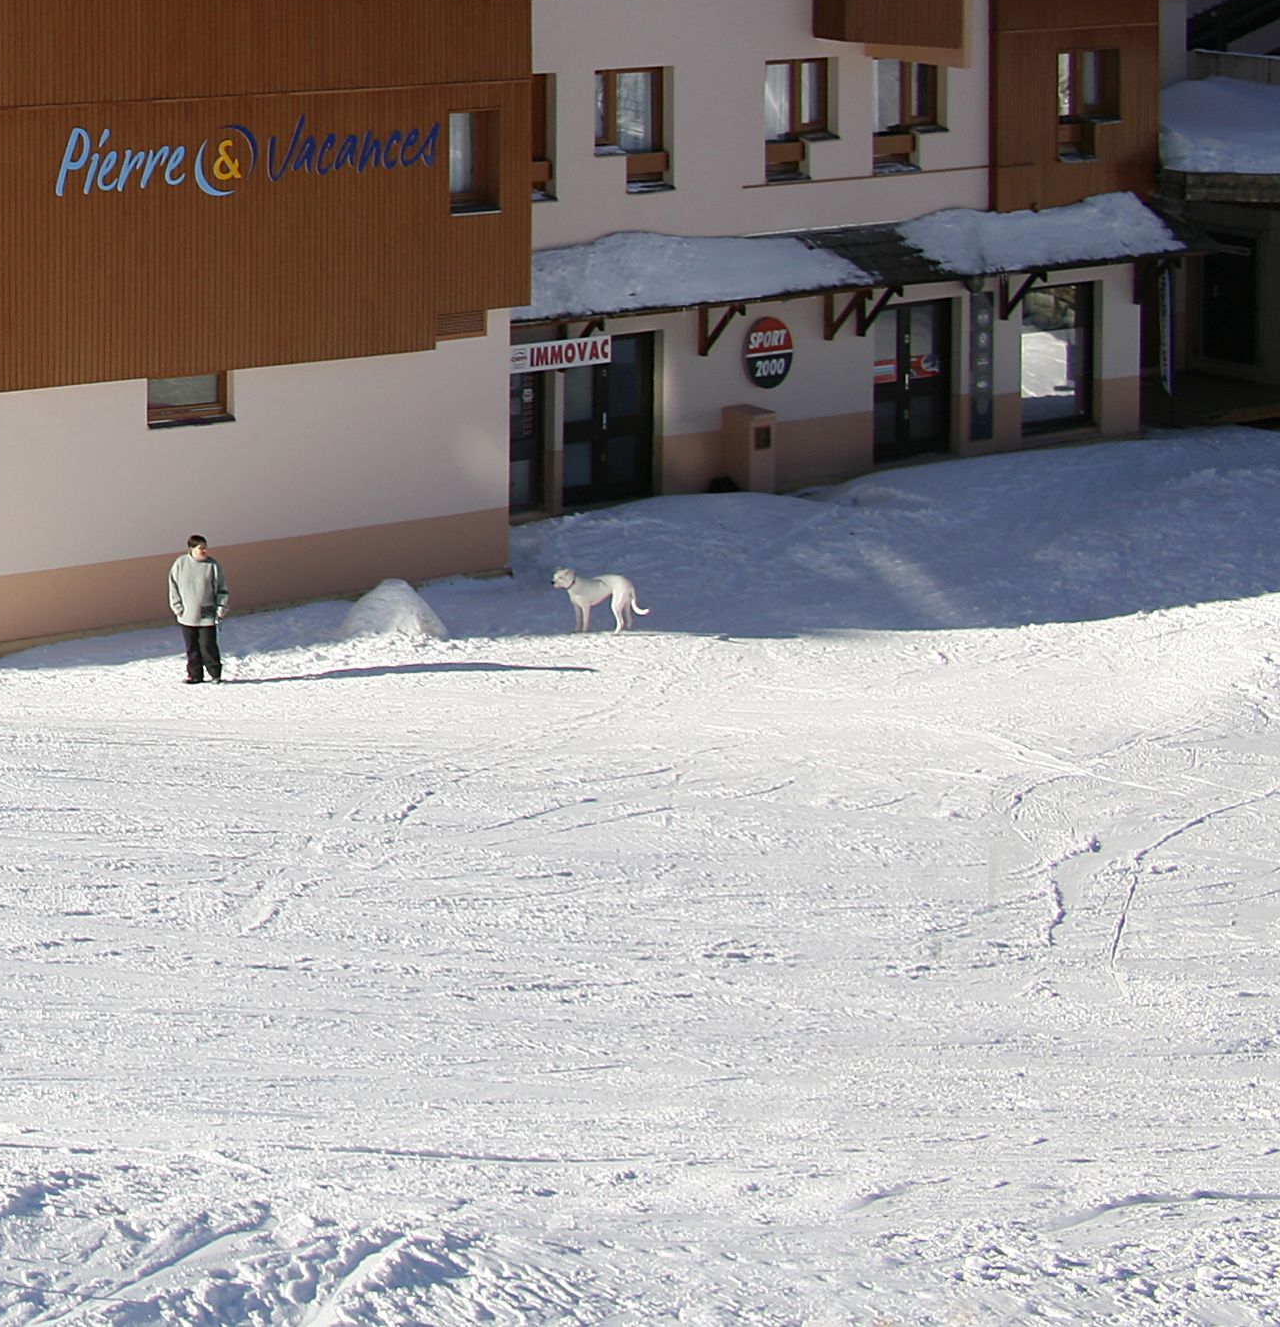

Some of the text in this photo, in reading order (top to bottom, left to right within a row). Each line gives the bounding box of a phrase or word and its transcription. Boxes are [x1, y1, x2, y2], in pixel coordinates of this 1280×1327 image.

[55, 113, 440, 197] Pierre & Vacances
[749, 329, 787, 349] SPORT
[530, 339, 609, 367] IMMOVAC
[755, 358, 785, 377] 2000
